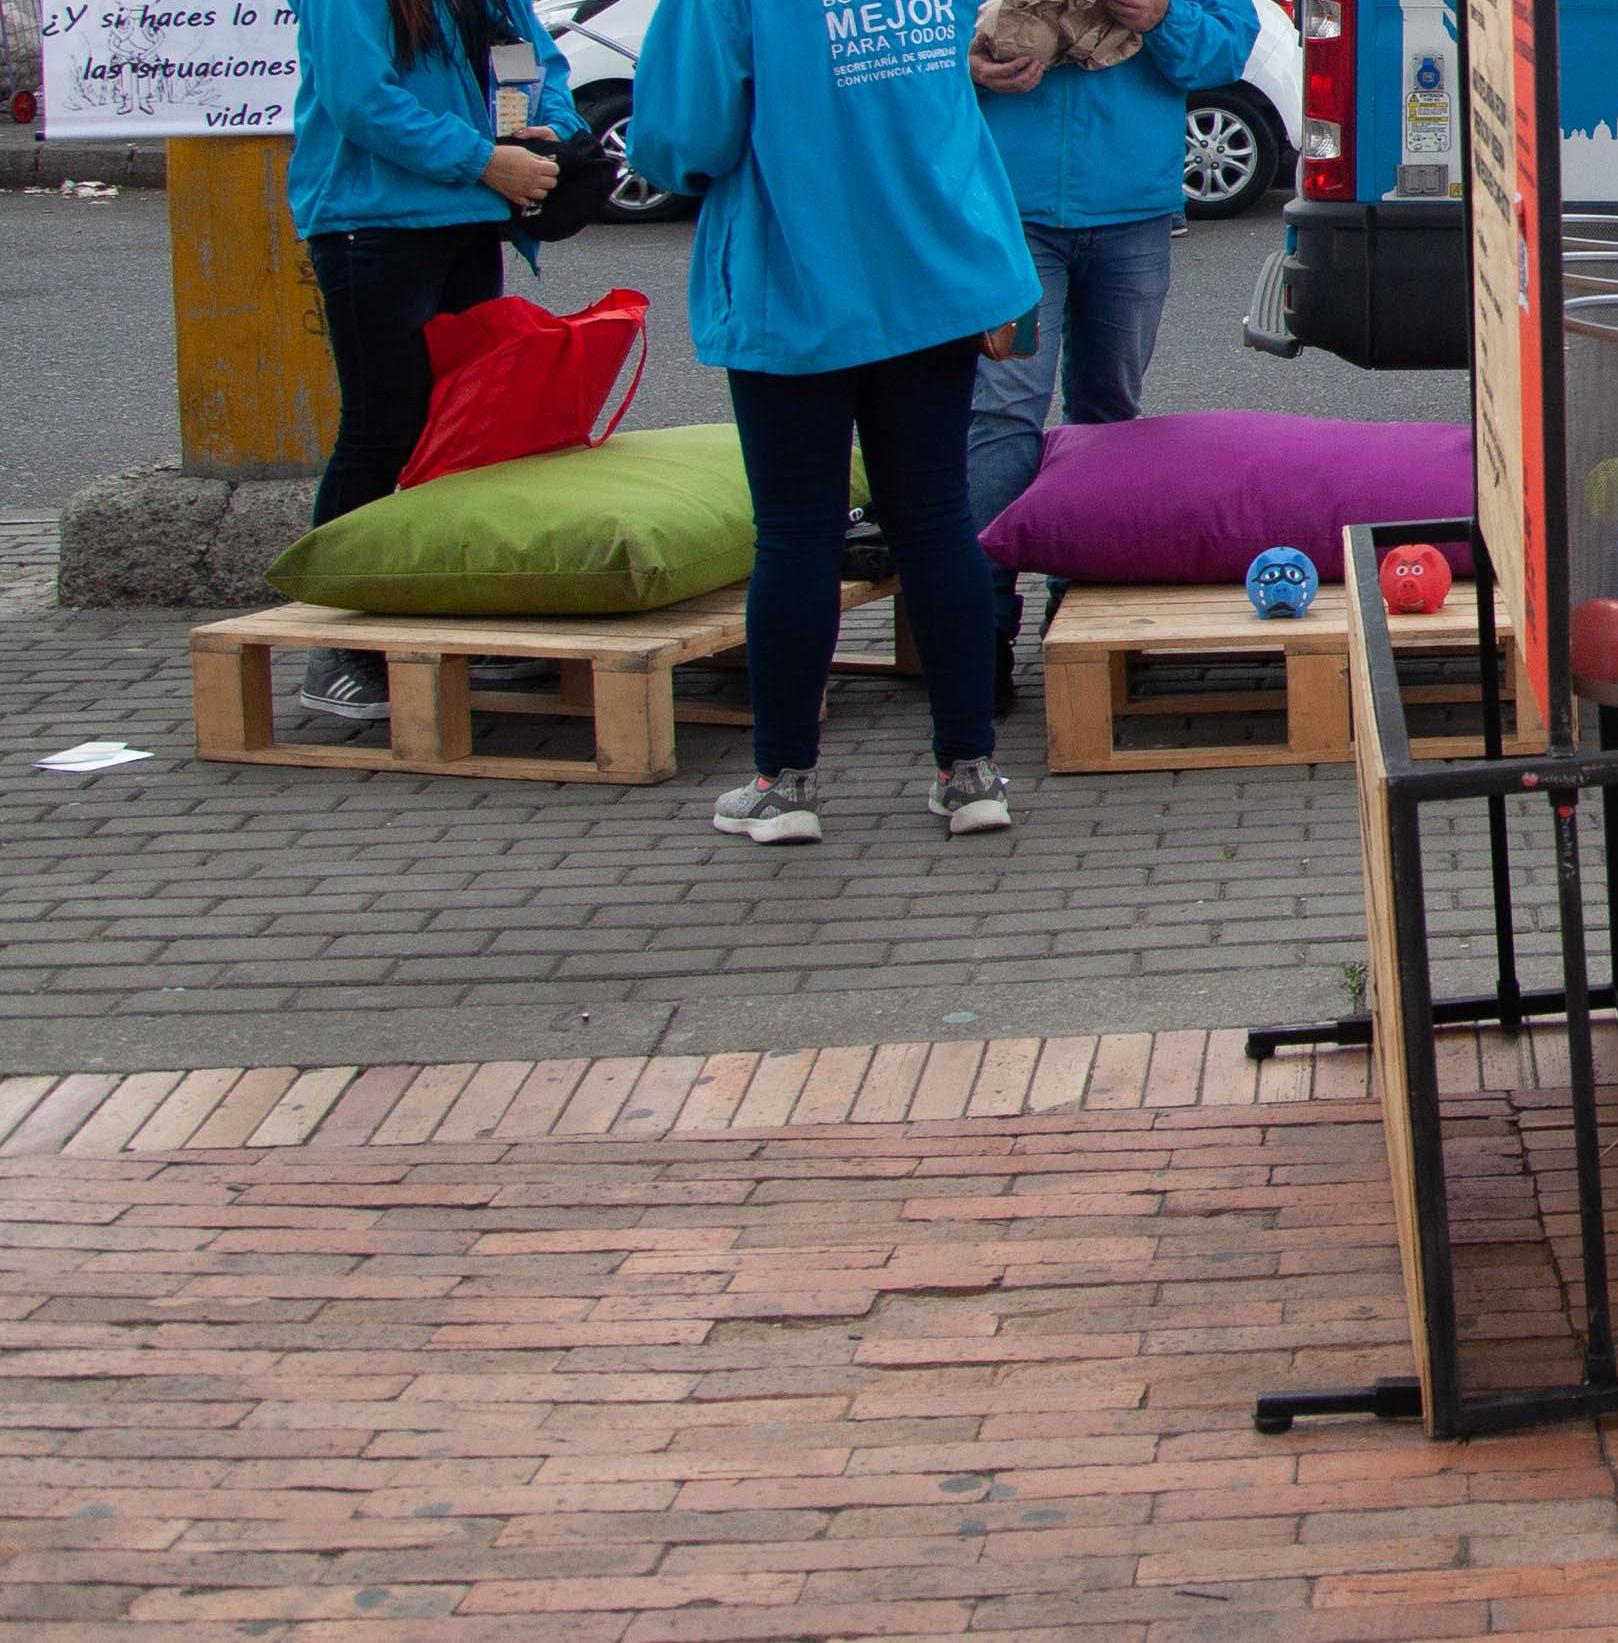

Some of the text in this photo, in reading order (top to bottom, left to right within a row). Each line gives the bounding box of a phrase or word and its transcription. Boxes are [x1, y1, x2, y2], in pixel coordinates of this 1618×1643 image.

[42, 5, 88, 37] ¿Y
[101, 7, 126, 28] si
[140, 5, 216, 27] haces
[232, 3, 258, 25] lo
[831, 24, 956, 60] PARA TODOS
[83, 56, 297, 80] las situaciones
[903, 52, 916, 62] DE
[836, 67, 913, 88] CONVIVENCIA
[916, 64, 923, 73] Y
[206, 104, 282, 127] vida?
